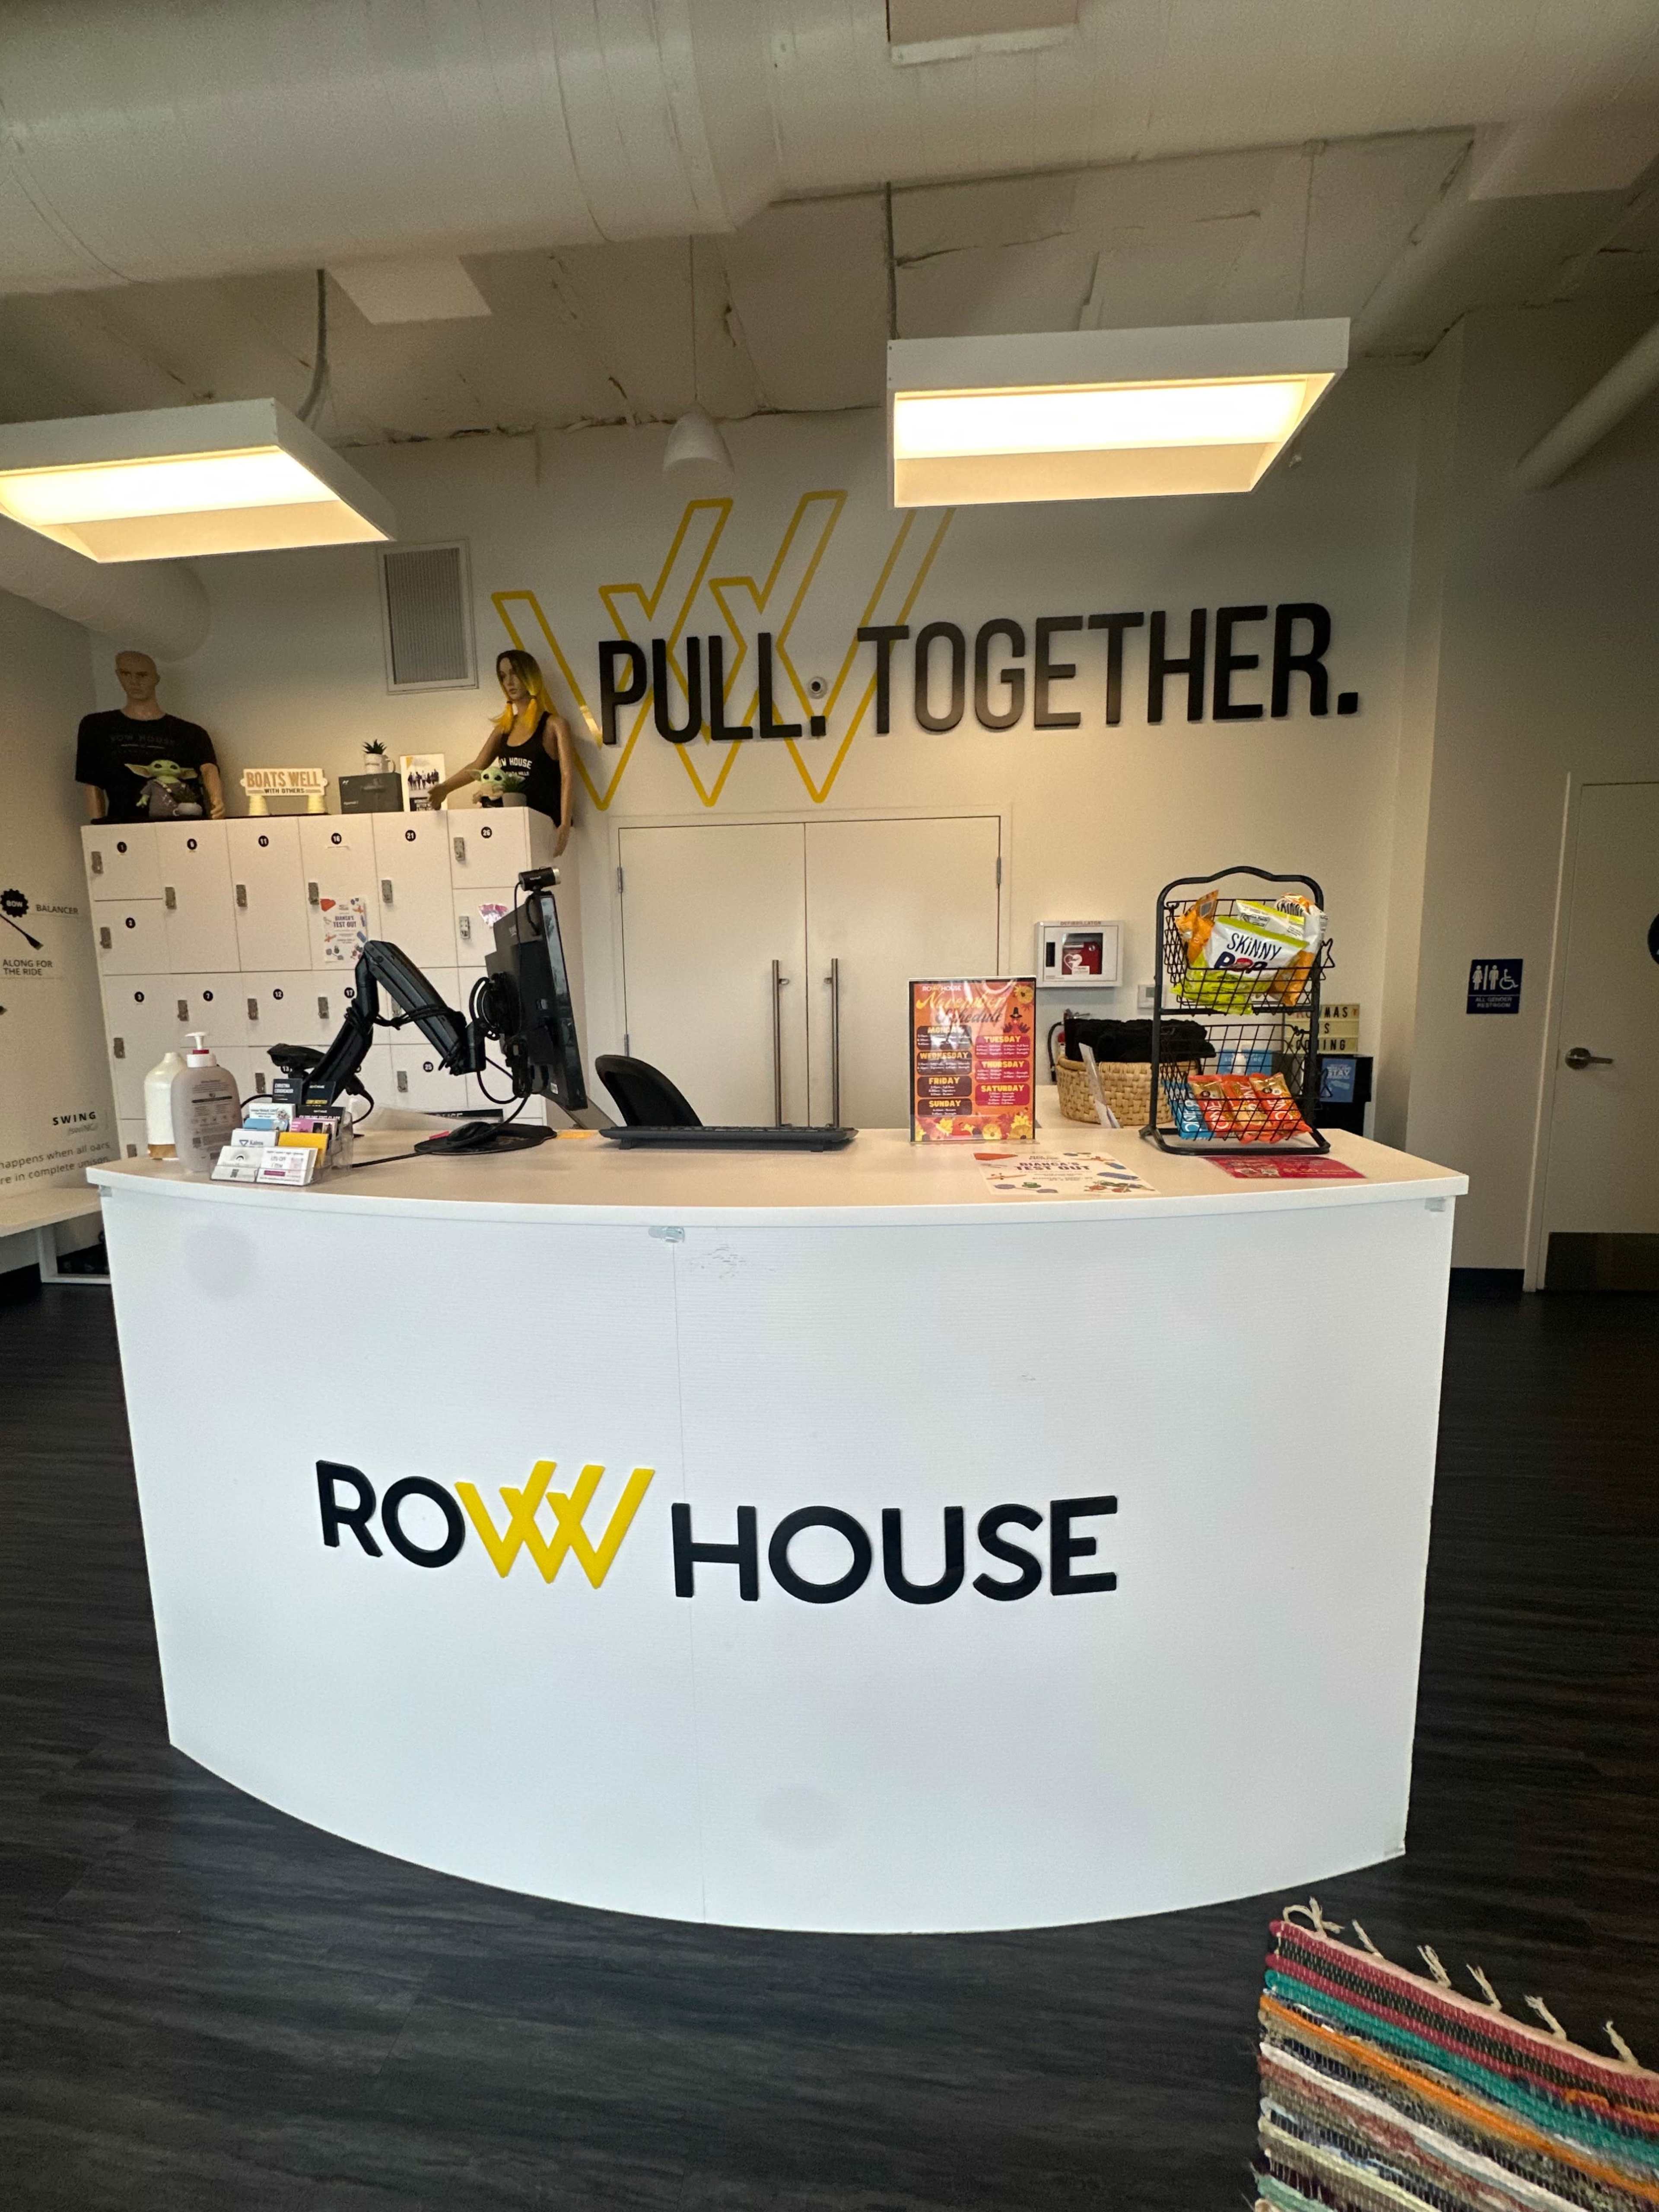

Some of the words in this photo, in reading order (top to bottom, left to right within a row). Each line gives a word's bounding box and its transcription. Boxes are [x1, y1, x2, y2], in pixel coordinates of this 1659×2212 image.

[598, 632, 826, 745] PULL.
[857, 603, 1358, 734] TOGETHER.
[509, 757, 532, 769] HOUSE
[246, 771, 286, 788] BOATS
[288, 771, 321, 787] WELL
[36, 904, 79, 915] BALANCER
[3, 959, 34, 967] ALONG
[52, 1112, 96, 1125] SWING
[47, 1149, 73, 1160] when
[76, 1144, 87, 1154] all
[89, 1142, 111, 1152] oars
[15, 1173, 25, 1182] in
[28, 1162, 75, 1179] complete
[316, 1460, 655, 1589] ROW
[671, 1495, 1118, 1605] HOUSE
